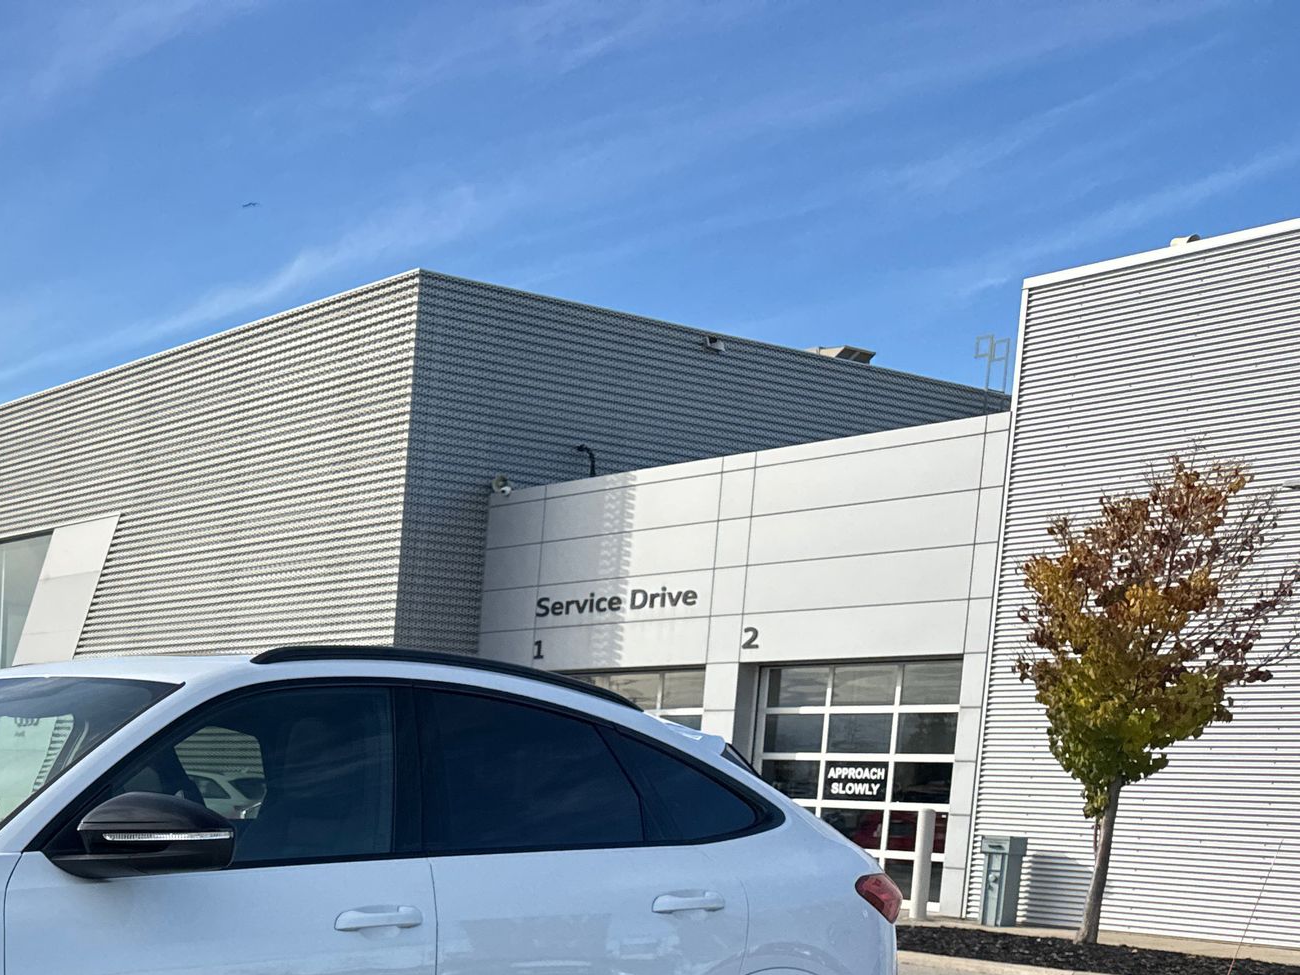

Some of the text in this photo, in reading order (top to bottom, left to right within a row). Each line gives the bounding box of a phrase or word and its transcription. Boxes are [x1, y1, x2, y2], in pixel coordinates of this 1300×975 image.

[535, 586, 698, 617] Service Drive
[741, 627, 759, 649] 2
[533, 640, 544, 660] 1
[827, 767, 886, 780] APPROACH
[830, 782, 880, 796] SLOWLY
